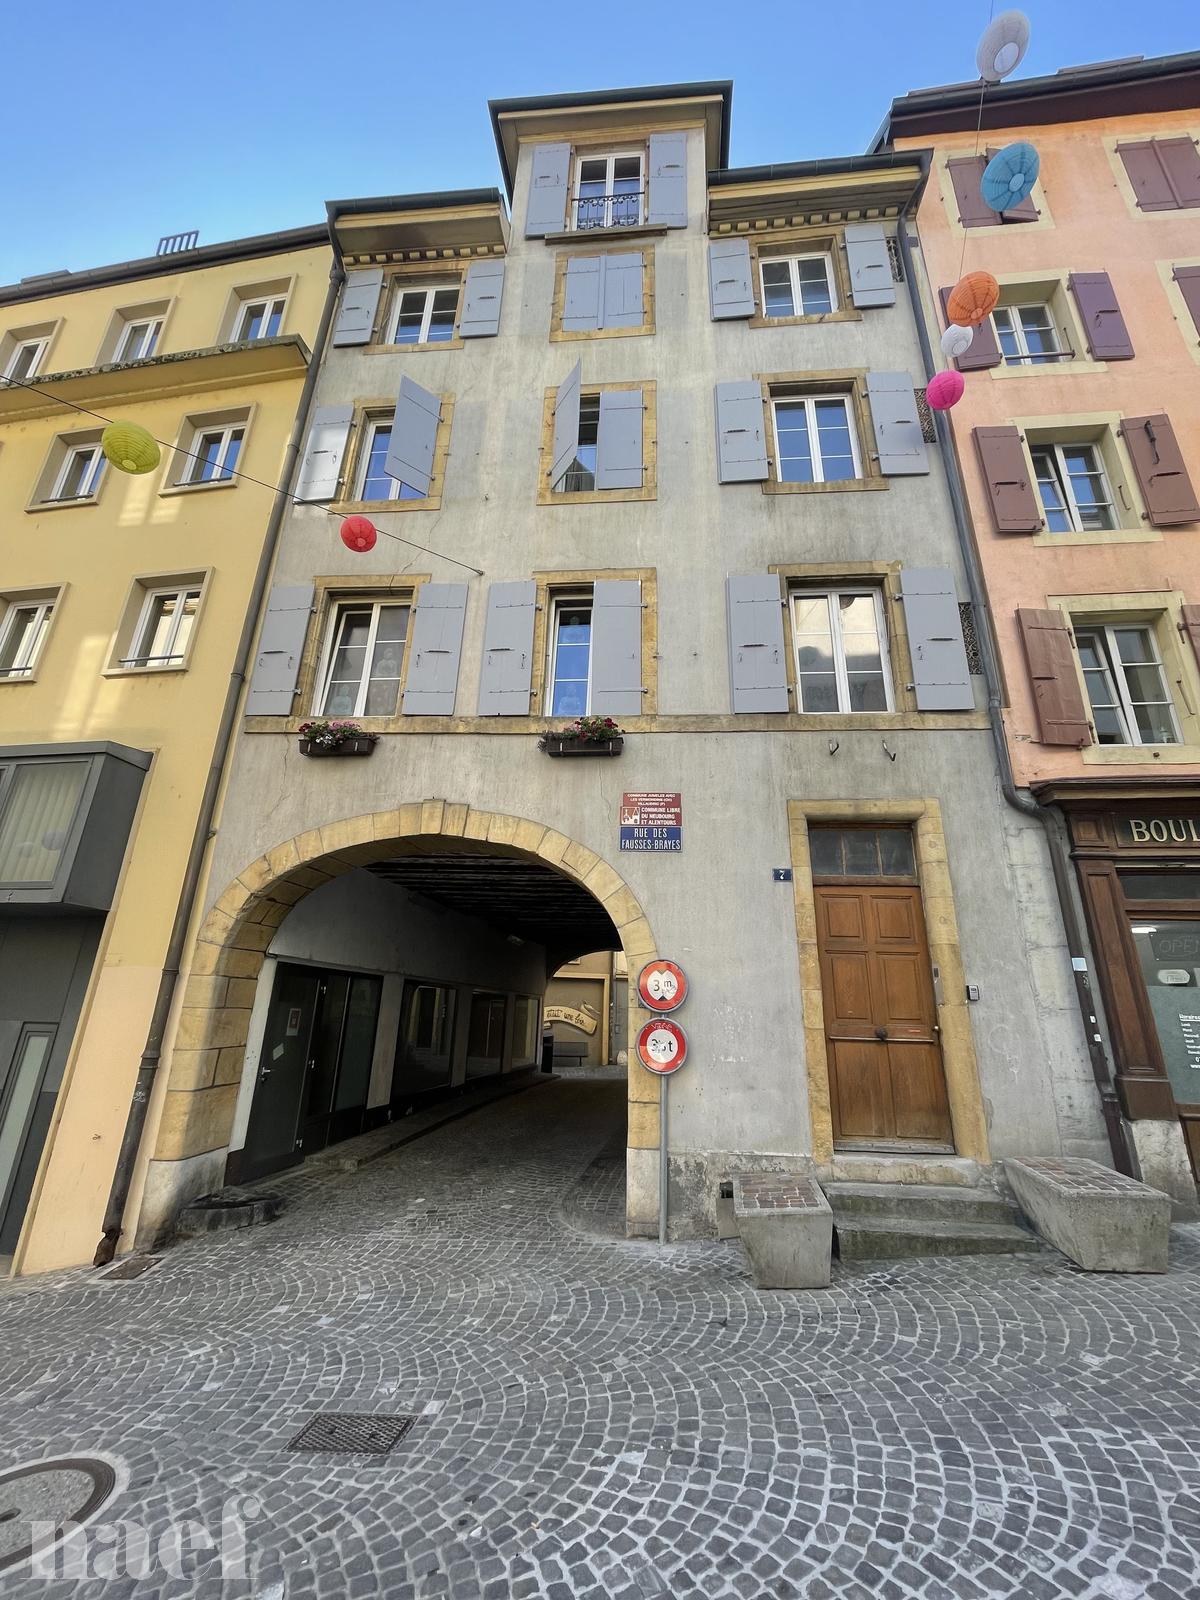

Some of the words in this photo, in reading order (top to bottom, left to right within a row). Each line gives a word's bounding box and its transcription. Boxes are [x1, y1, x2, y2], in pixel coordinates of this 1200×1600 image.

[634, 828, 649, 838] RUE
[653, 828, 668, 838] DES
[1129, 819, 1200, 842] BOUL
[621, 839, 681, 850] FAUSSES-BRAYES
[779, 870, 785, 880] 7
[653, 979, 660, 992] 3
[664, 980, 672, 988] m
